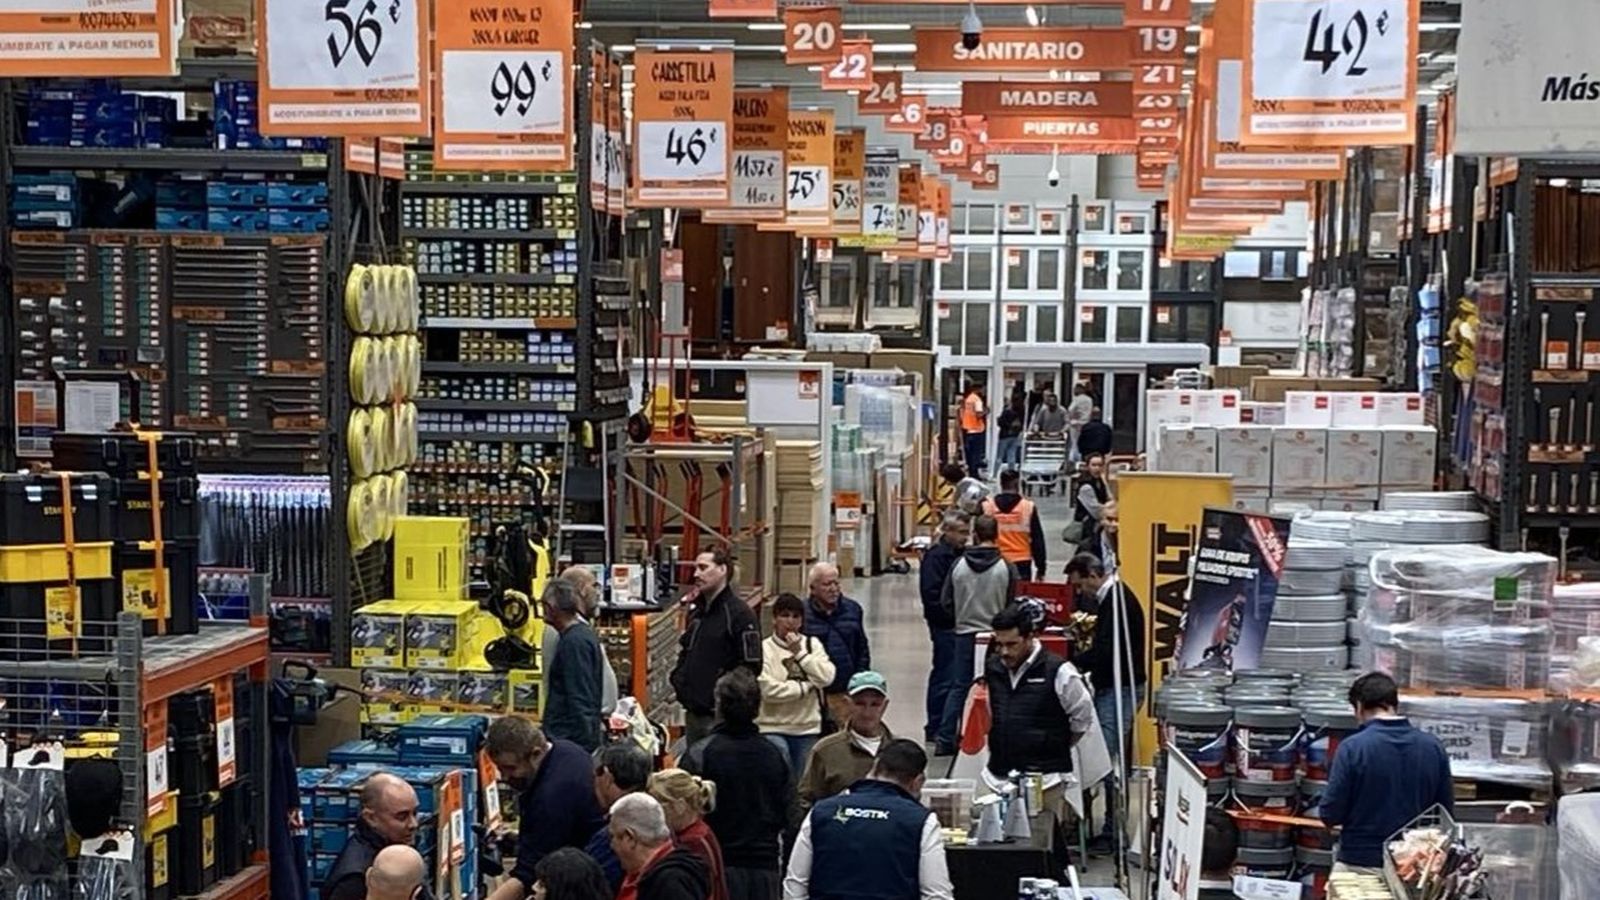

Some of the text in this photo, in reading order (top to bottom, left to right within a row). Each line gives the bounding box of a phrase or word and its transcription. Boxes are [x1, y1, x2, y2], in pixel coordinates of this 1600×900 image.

[68, 40, 109, 51] PAGAR
[112, 39, 155, 50] MENOS
[325, 0, 383, 69] 56
[793, 22, 836, 50] 20
[1140, 27, 1179, 51] 19
[1303, 8, 1369, 77] 42
[953, 41, 1084, 61] SANITARIO
[828, 54, 867, 79] 22
[491, 61, 536, 117] 99
[864, 82, 898, 104] 24
[1001, 90, 1098, 106] MADERA
[1541, 72, 1600, 102] Más
[1023, 121, 1100, 135] PUERTAS
[665, 127, 707, 166] 46
[788, 171, 816, 200] 75
[845, 808, 890, 820] BOSTIK
